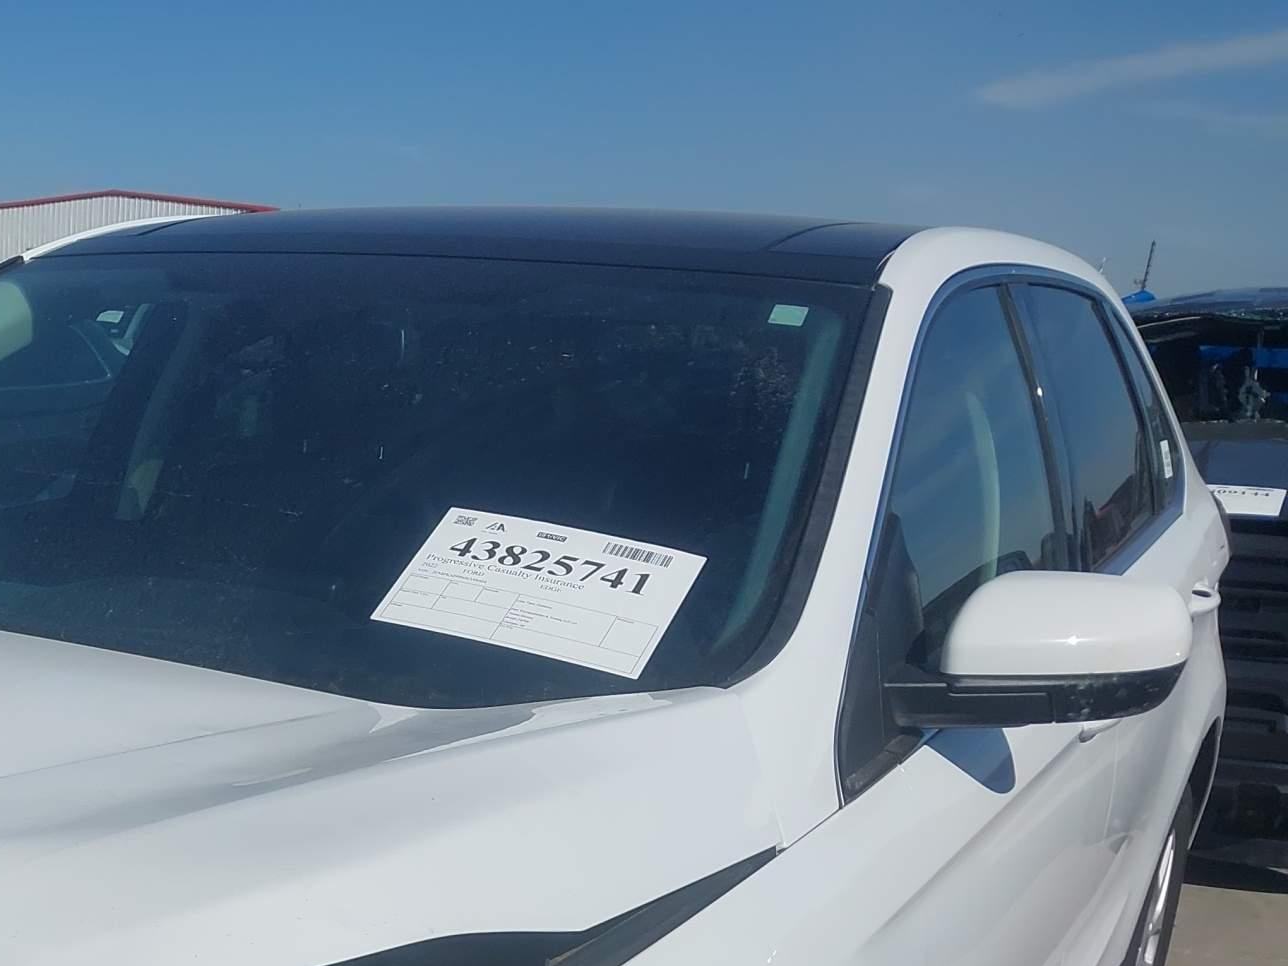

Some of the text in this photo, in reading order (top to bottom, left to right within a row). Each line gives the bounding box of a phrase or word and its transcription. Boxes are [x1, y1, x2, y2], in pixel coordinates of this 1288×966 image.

[426, 553, 487, 571] Progressive
[487, 564, 531, 580] Casualty
[534, 574, 585, 590] Insurance
[448, 536, 651, 596] 43825741
[462, 568, 486, 577] FORD
